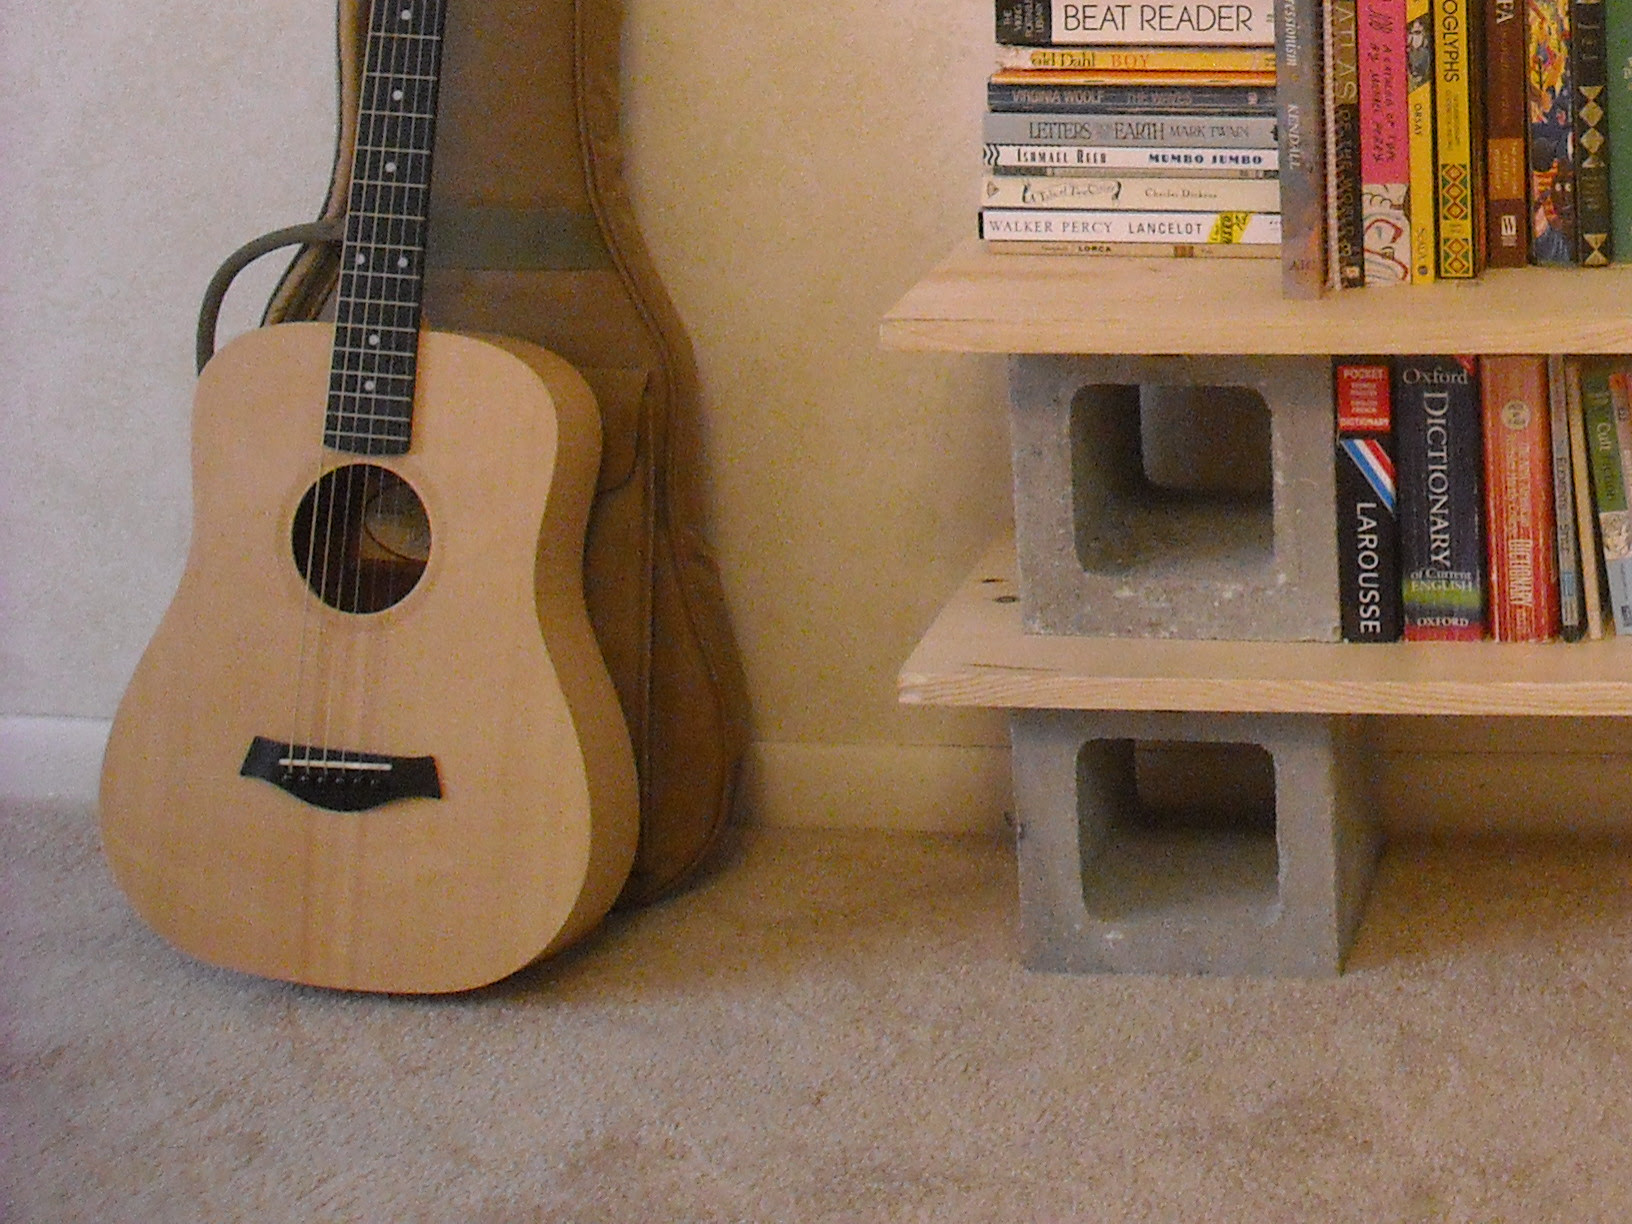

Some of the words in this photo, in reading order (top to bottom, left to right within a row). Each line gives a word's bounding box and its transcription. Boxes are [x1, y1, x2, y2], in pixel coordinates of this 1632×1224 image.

[1063, 3, 1133, 32] BEAT
[1140, 3, 1253, 32] READER
[1031, 51, 1056, 67] ald
[1061, 51, 1096, 67] Dahl
[1111, 54, 1151, 68] BOY
[1335, 5, 1359, 105] ATLAS
[1028, 121, 1093, 140] LETTERS
[1113, 121, 1166, 141] EARTH
[1286, 103, 1301, 171] KENDALL
[1148, 153, 1205, 165] MUMBO
[1211, 154, 1263, 166] JUMBO
[988, 220, 1054, 234] WALKER
[1061, 221, 1113, 235] PERCY
[1128, 221, 1203, 236] LANCELOT
[1402, 367, 1468, 385] Oxford
[1422, 391, 1452, 568] DICTIONARY
[1356, 502, 1381, 634] LAROUSSE
[1410, 570, 1422, 580] of
[1425, 567, 1472, 580] Current
[1508, 539, 1534, 607] DICTIONARY
[1410, 579, 1473, 592] ENGLISH
[1416, 616, 1469, 627] OXFORD
